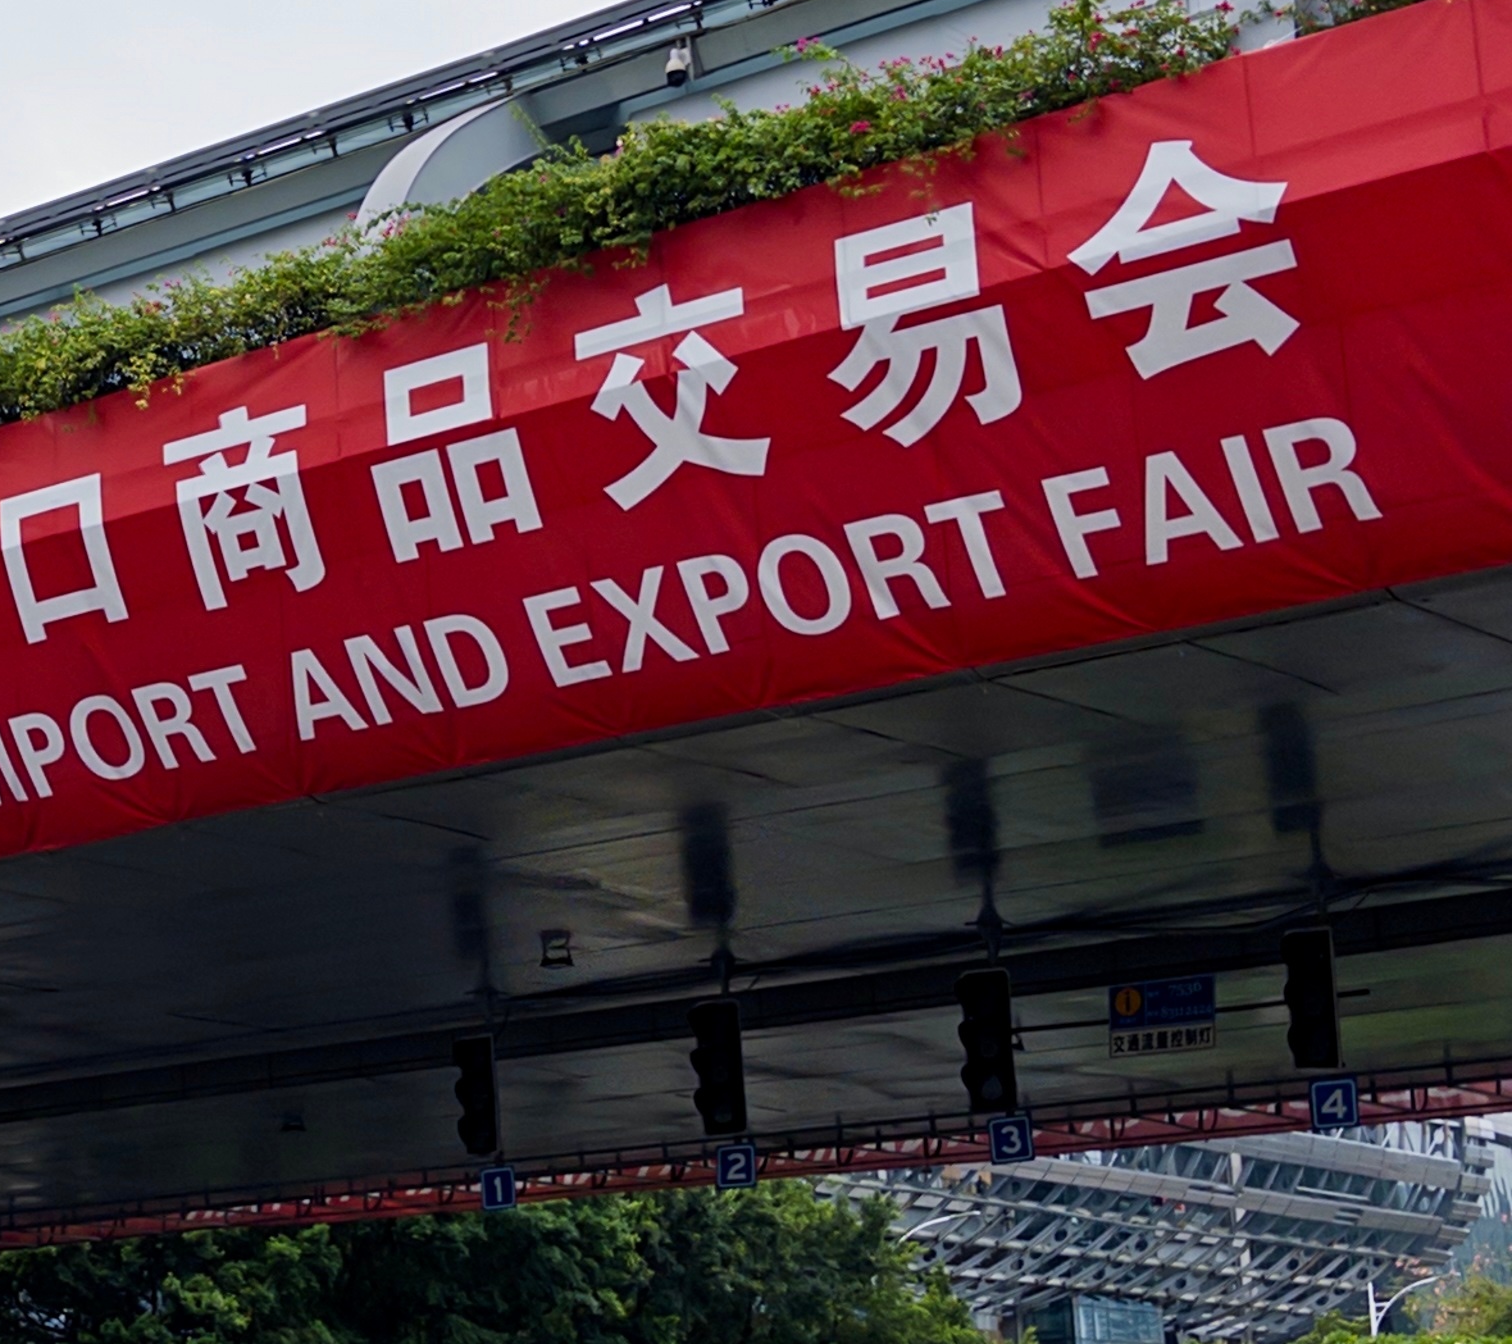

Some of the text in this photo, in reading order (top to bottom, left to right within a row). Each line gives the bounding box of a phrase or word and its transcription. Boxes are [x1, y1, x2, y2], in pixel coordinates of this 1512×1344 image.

[291, 613, 509, 742] AND
[522, 490, 1007, 688] EXPORT
[1041, 416, 1383, 579] FAIR
[1318, 1088, 1349, 1120] 4
[999, 1124, 1023, 1156] 3
[726, 1155, 747, 1181] 2
[492, 1176, 504, 1204] 1
